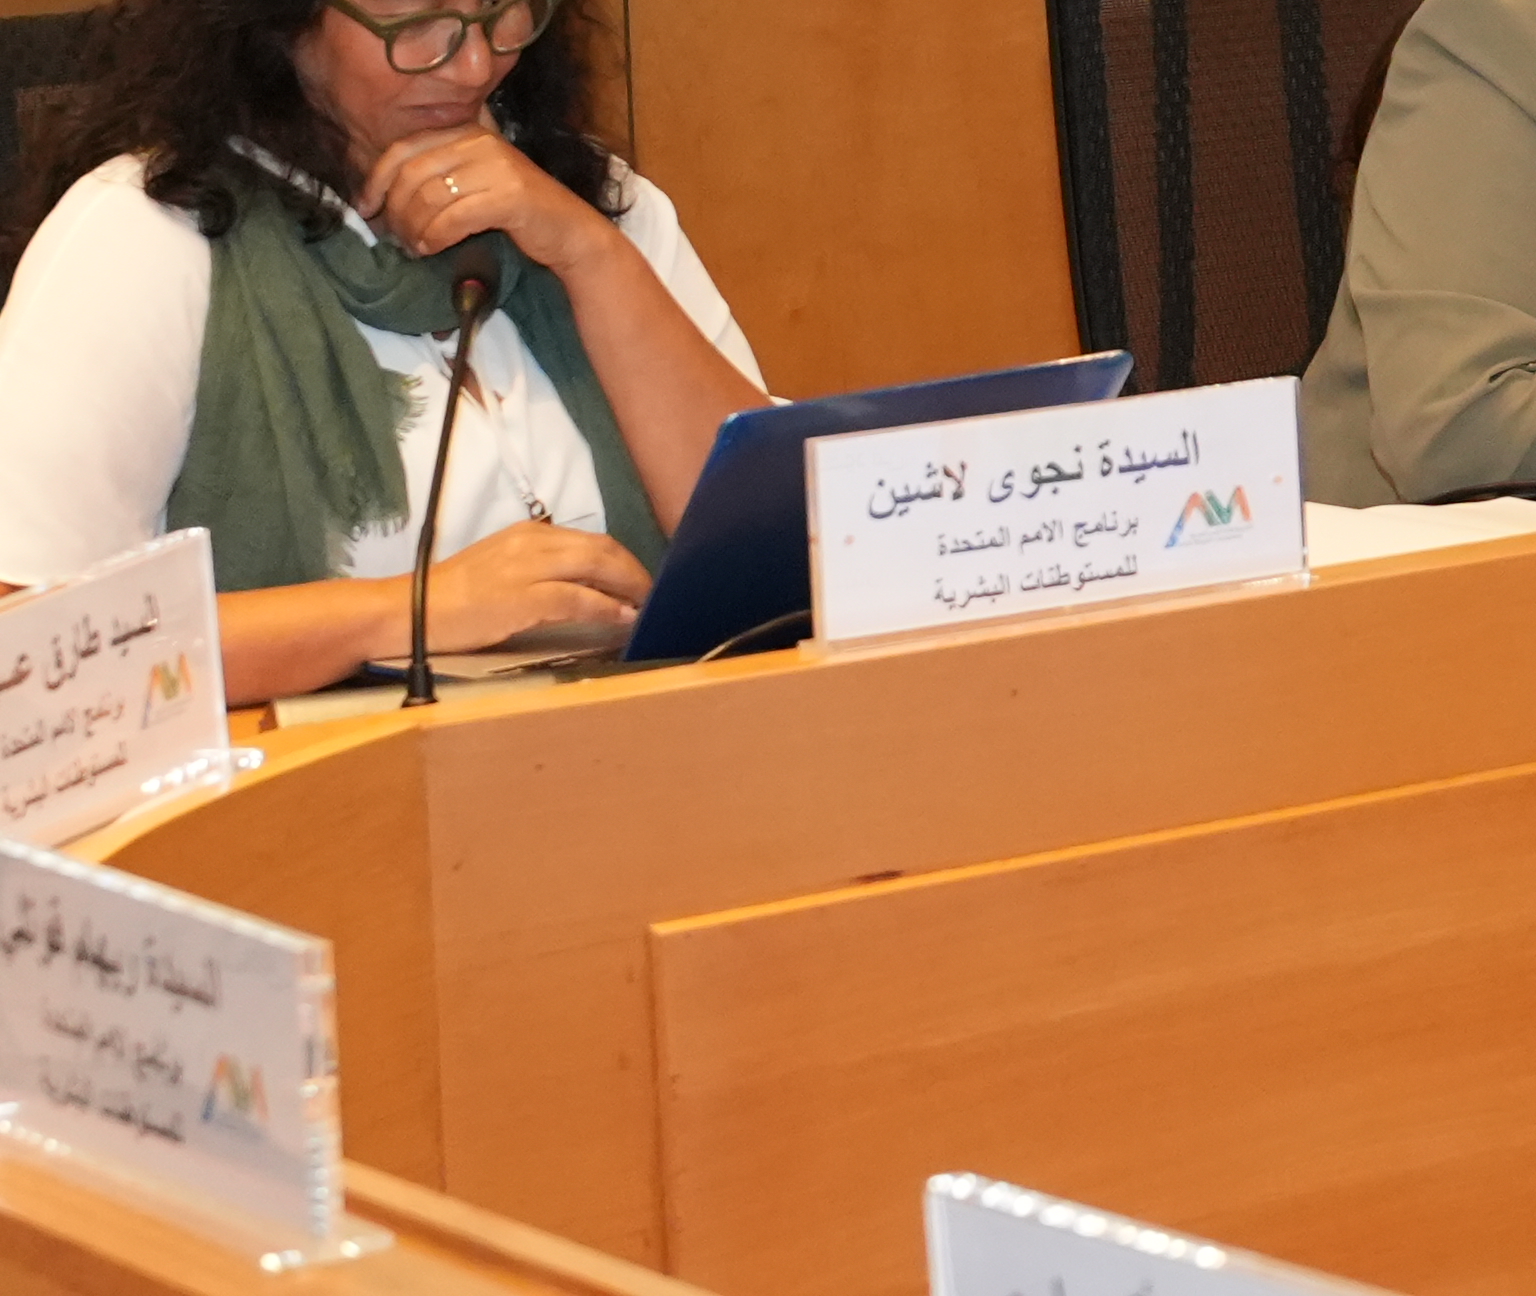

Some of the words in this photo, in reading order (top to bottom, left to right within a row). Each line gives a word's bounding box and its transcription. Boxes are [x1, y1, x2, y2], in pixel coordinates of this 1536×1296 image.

[988, 444, 1084, 503] نجوى
[1100, 431, 1200, 484] السيدة
[867, 461, 968, 518] لاشين
[937, 525, 1010, 557] المتحدة
[1074, 511, 1139, 548] برنامج
[934, 571, 1011, 608] البشرية
[1019, 553, 1139, 595] للمستوطنات
